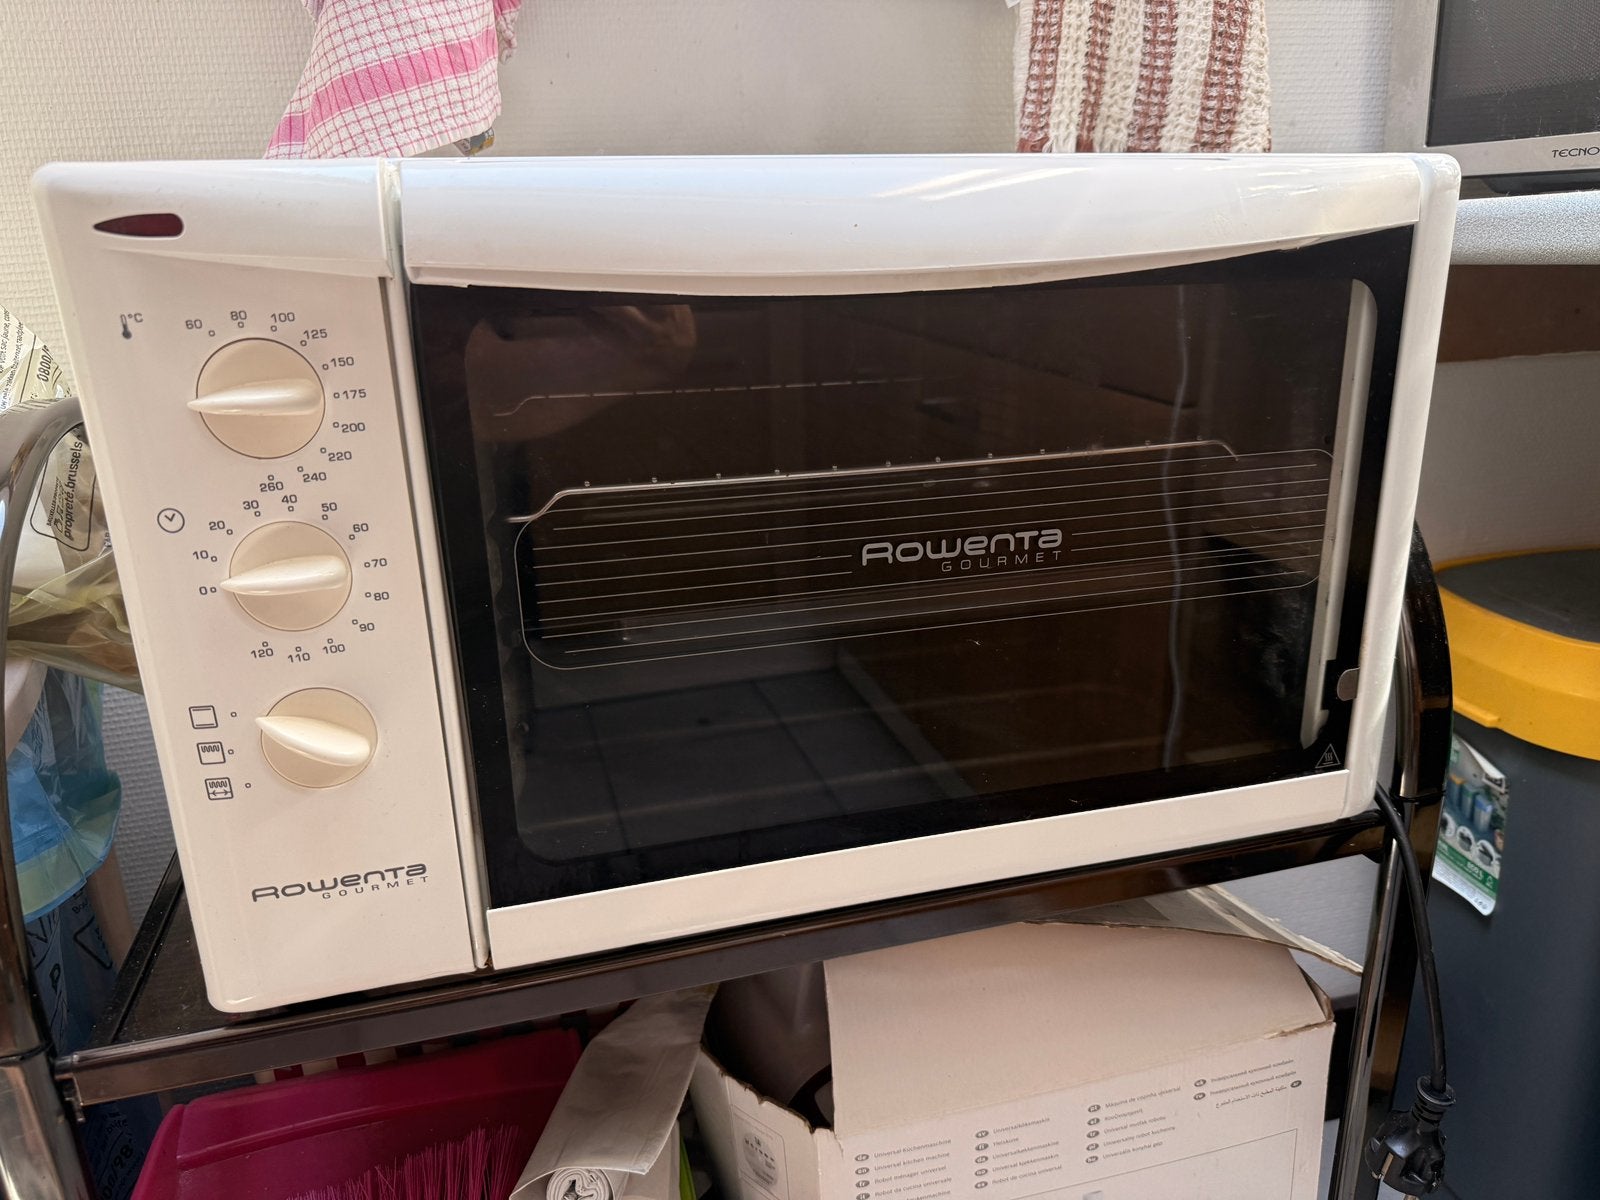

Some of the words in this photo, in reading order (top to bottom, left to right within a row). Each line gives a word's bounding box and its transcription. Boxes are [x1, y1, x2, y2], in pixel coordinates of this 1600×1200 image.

[230, 310, 247, 321] 80
[270, 312, 295, 323] 100
[185, 319, 202, 330] 60
[303, 328, 328, 340] 125
[330, 356, 354, 367] 150
[342, 388, 366, 400] 175
[342, 422, 366, 433] 200
[328, 450, 352, 462] 220
[302, 472, 326, 482] 240
[260, 482, 284, 492] 260
[282, 494, 298, 504] 40
[243, 500, 259, 510] 30
[322, 502, 338, 512] 50
[208, 520, 226, 530] 20
[353, 523, 369, 533] 60
[192, 550, 209, 560] 10
[371, 558, 388, 568] 70
[942, 550, 1062, 572] GOURMET
[199, 586, 208, 595] 0
[374, 592, 390, 601] 80
[359, 622, 375, 632] 90
[251, 648, 274, 659] 120
[322, 643, 346, 655] 100
[288, 652, 310, 663] 110
[322, 876, 428, 900] GOURMET
